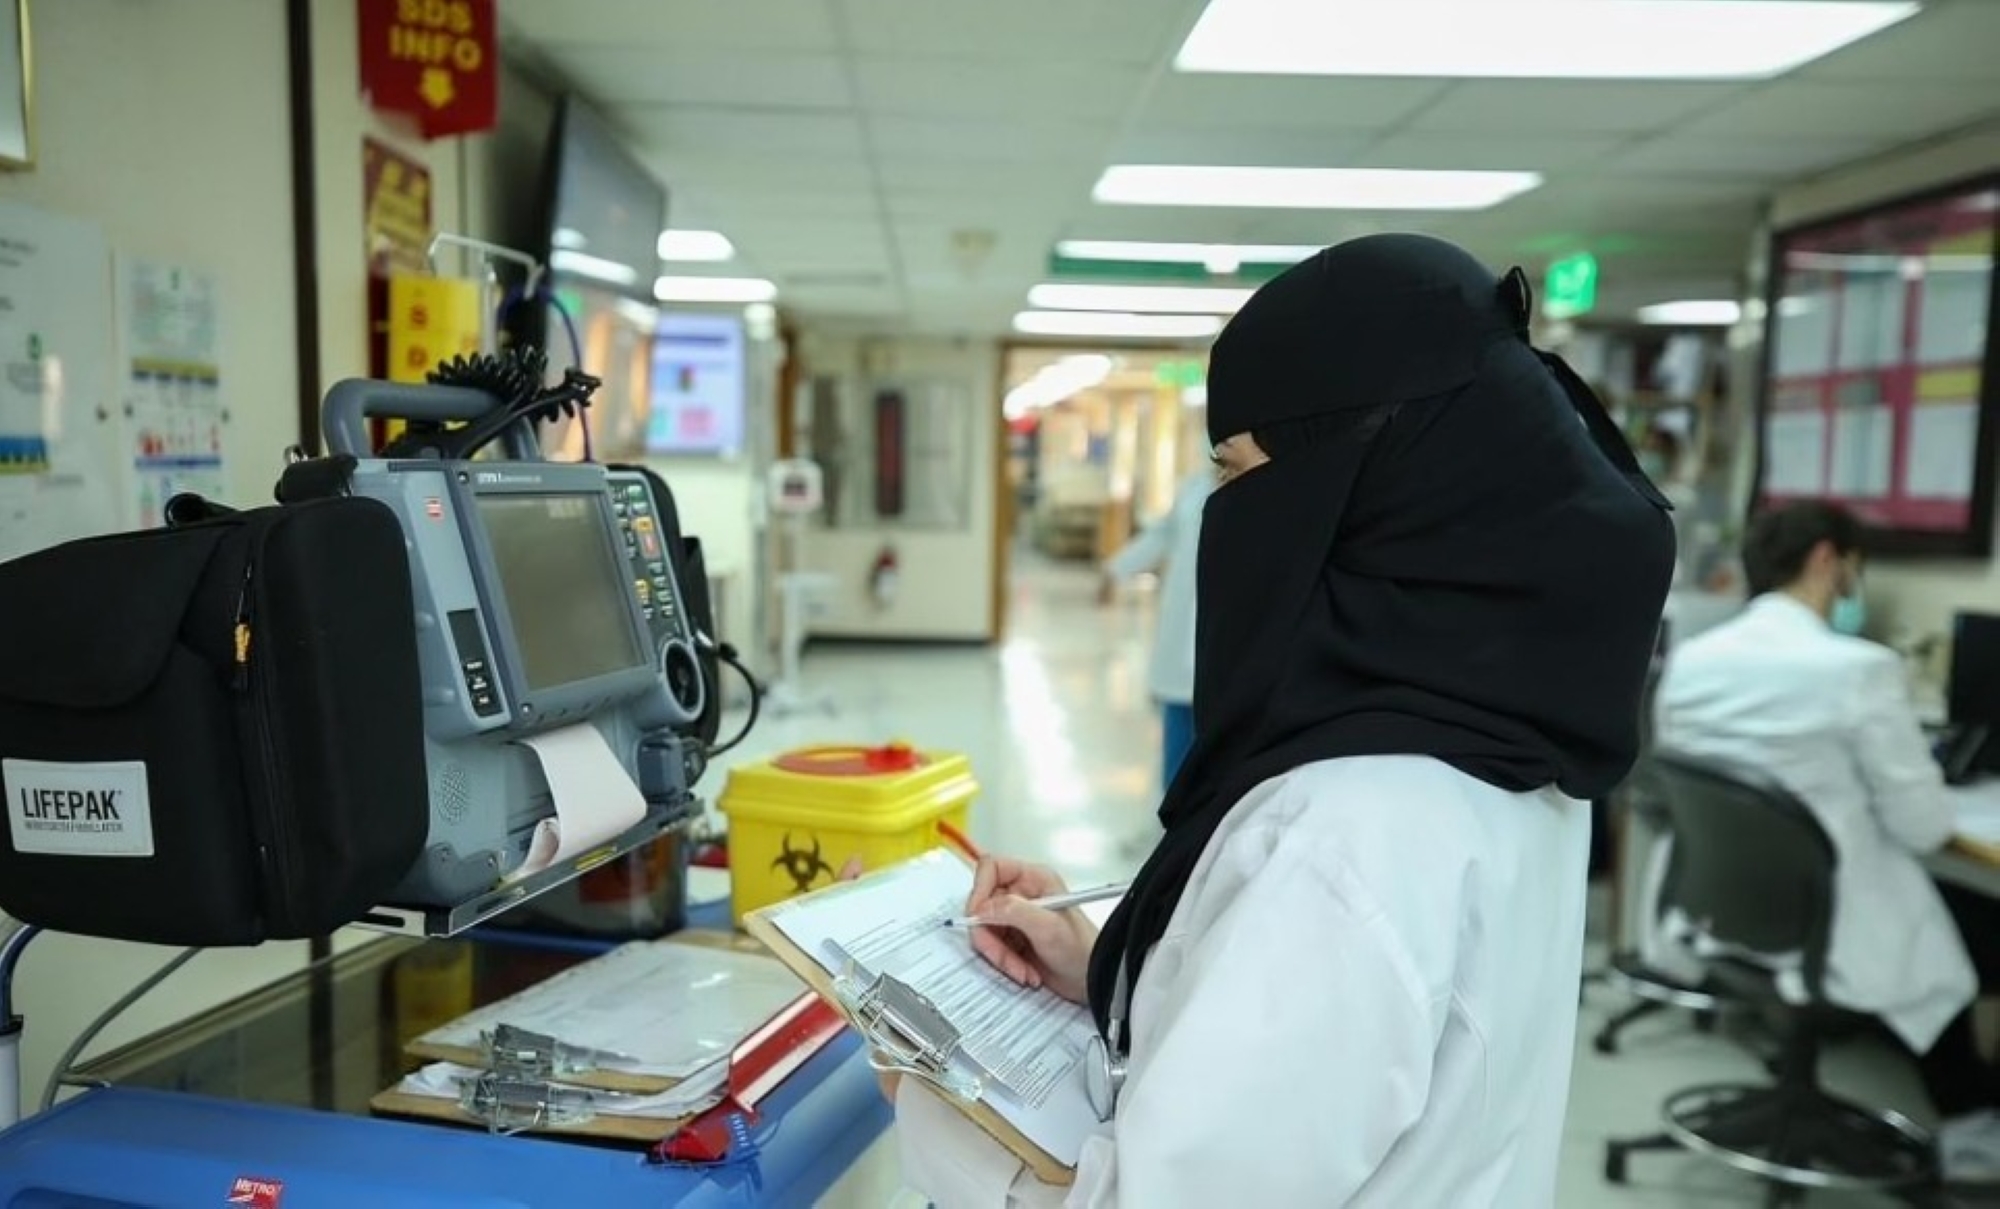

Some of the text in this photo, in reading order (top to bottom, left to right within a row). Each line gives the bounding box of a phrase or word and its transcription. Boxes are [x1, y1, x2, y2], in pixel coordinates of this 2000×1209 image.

[397, 0, 473, 33] SDS
[389, 24, 482, 70] INFO
[21, 787, 120, 821] LIFEPAK
